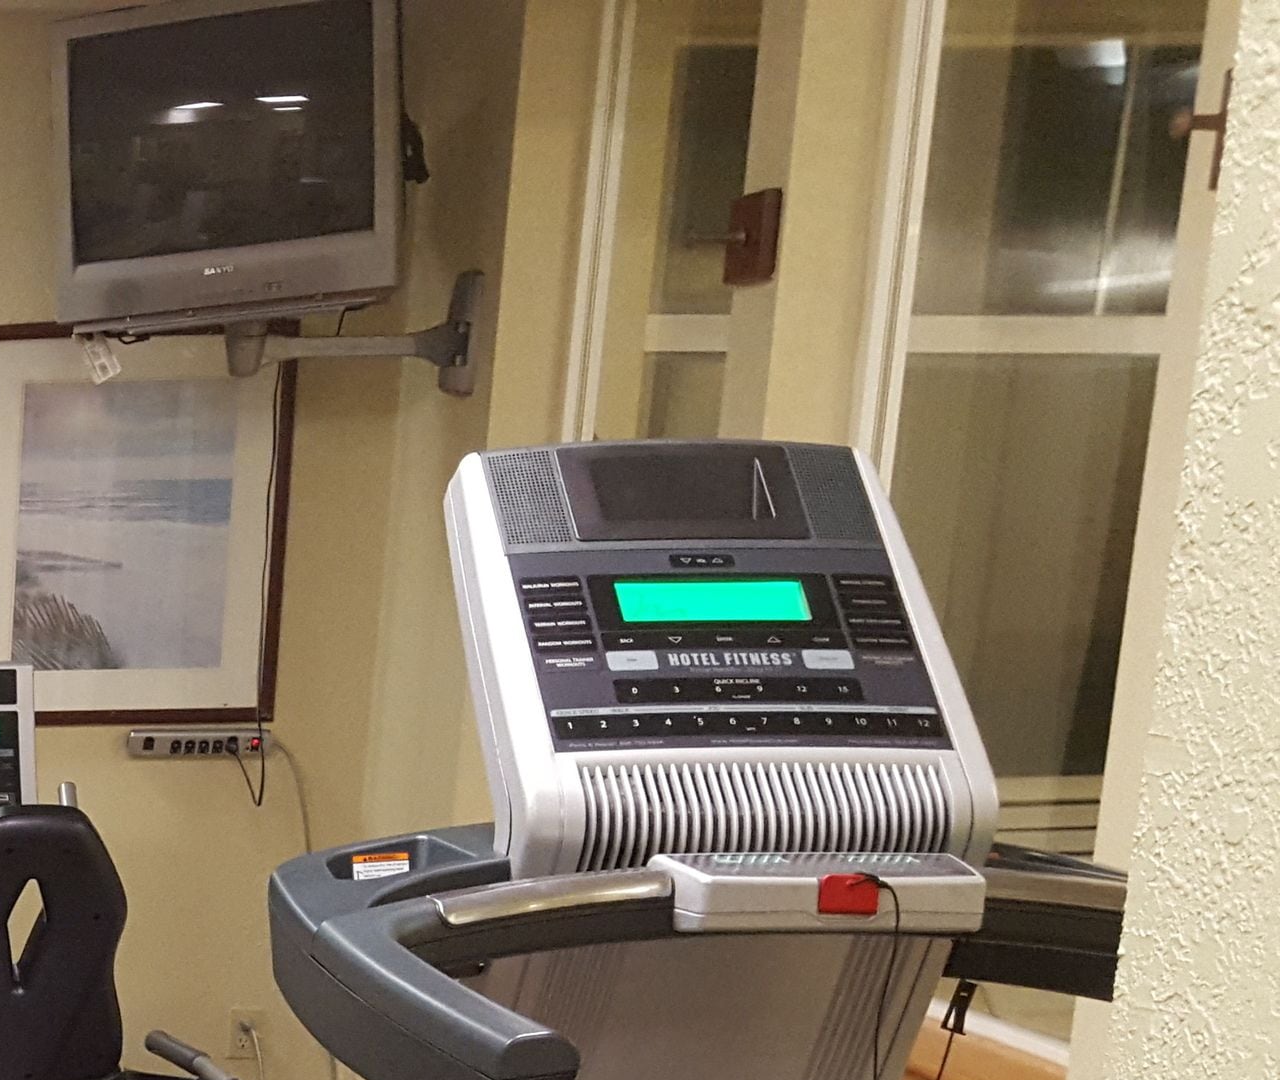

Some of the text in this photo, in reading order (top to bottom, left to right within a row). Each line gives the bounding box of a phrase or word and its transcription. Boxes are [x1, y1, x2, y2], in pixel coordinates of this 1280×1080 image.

[667, 651, 793, 667] HOTEL FITNESS
[796, 685, 807, 693] 12
[567, 717, 930, 730] 1 2 3 4 5 6 7 8 9 10 11 12
